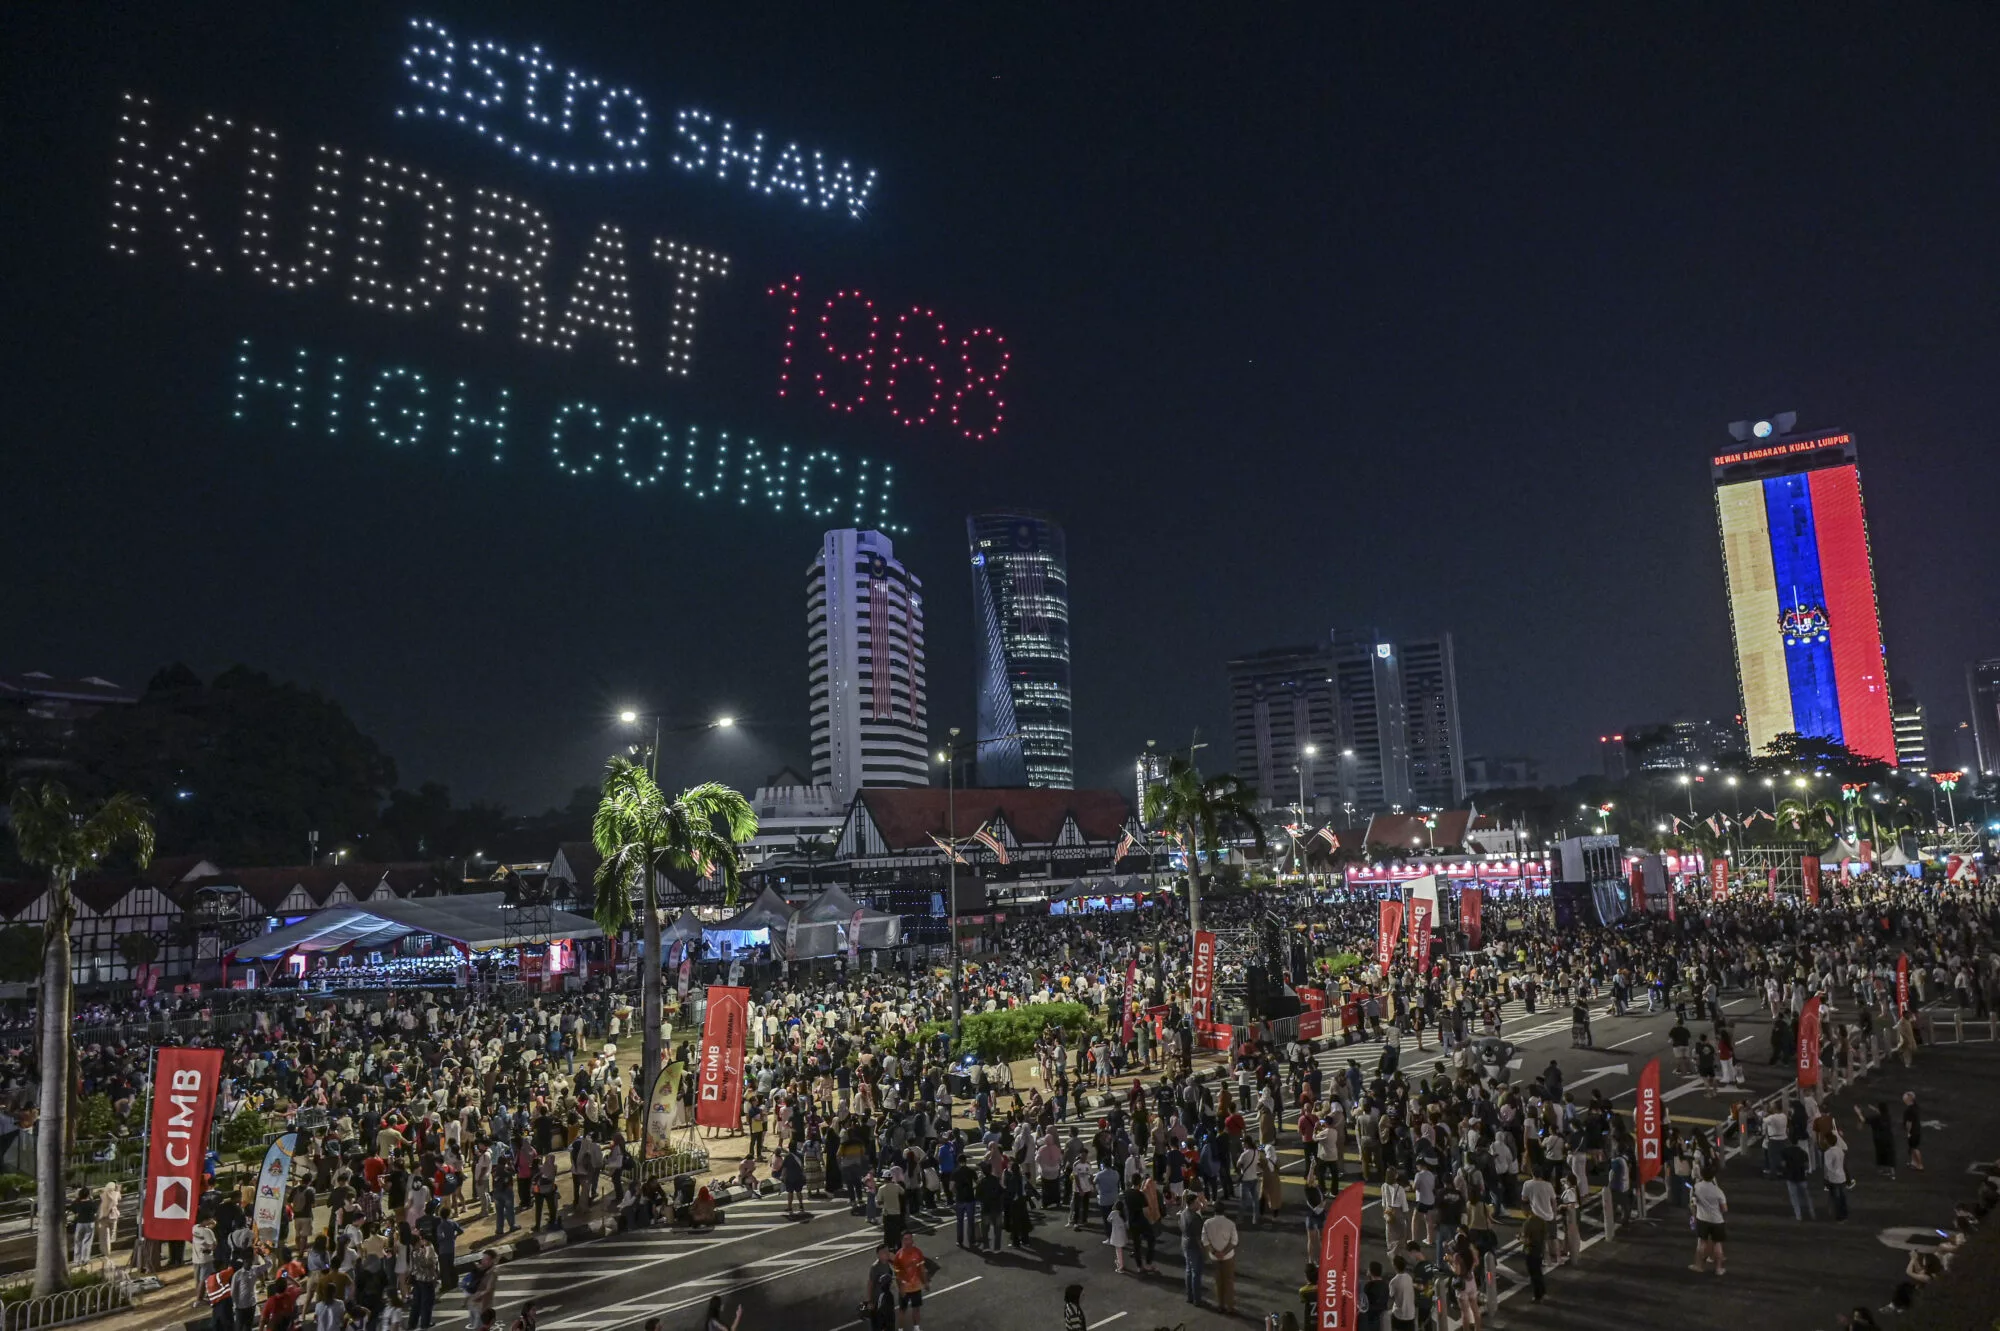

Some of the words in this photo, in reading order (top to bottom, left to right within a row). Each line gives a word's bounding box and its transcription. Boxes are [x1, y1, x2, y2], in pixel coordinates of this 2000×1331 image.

[674, 110, 878, 218] SHAW
[108, 92, 731, 376] KUDRAT
[767, 275, 1011, 440] 1968
[233, 338, 510, 463] HIGH
[551, 402, 909, 533] COUNCIL
[1714, 453, 1744, 466] DEWAN
[1743, 445, 1787, 461] BANDARAYA
[1789, 441, 1815, 453] KUALA
[1817, 434, 1850, 448] LUMPUR
[1715, 862, 1724, 889] CIMB
[1195, 942, 1210, 992] CIMB
[726, 1012, 734, 1048] FORWARD
[705, 1045, 720, 1082] CIMB
[165, 1069, 202, 1167] CIMB
[1644, 1088, 1655, 1135] CIMB
[1325, 1269, 1337, 1308] CIMB
